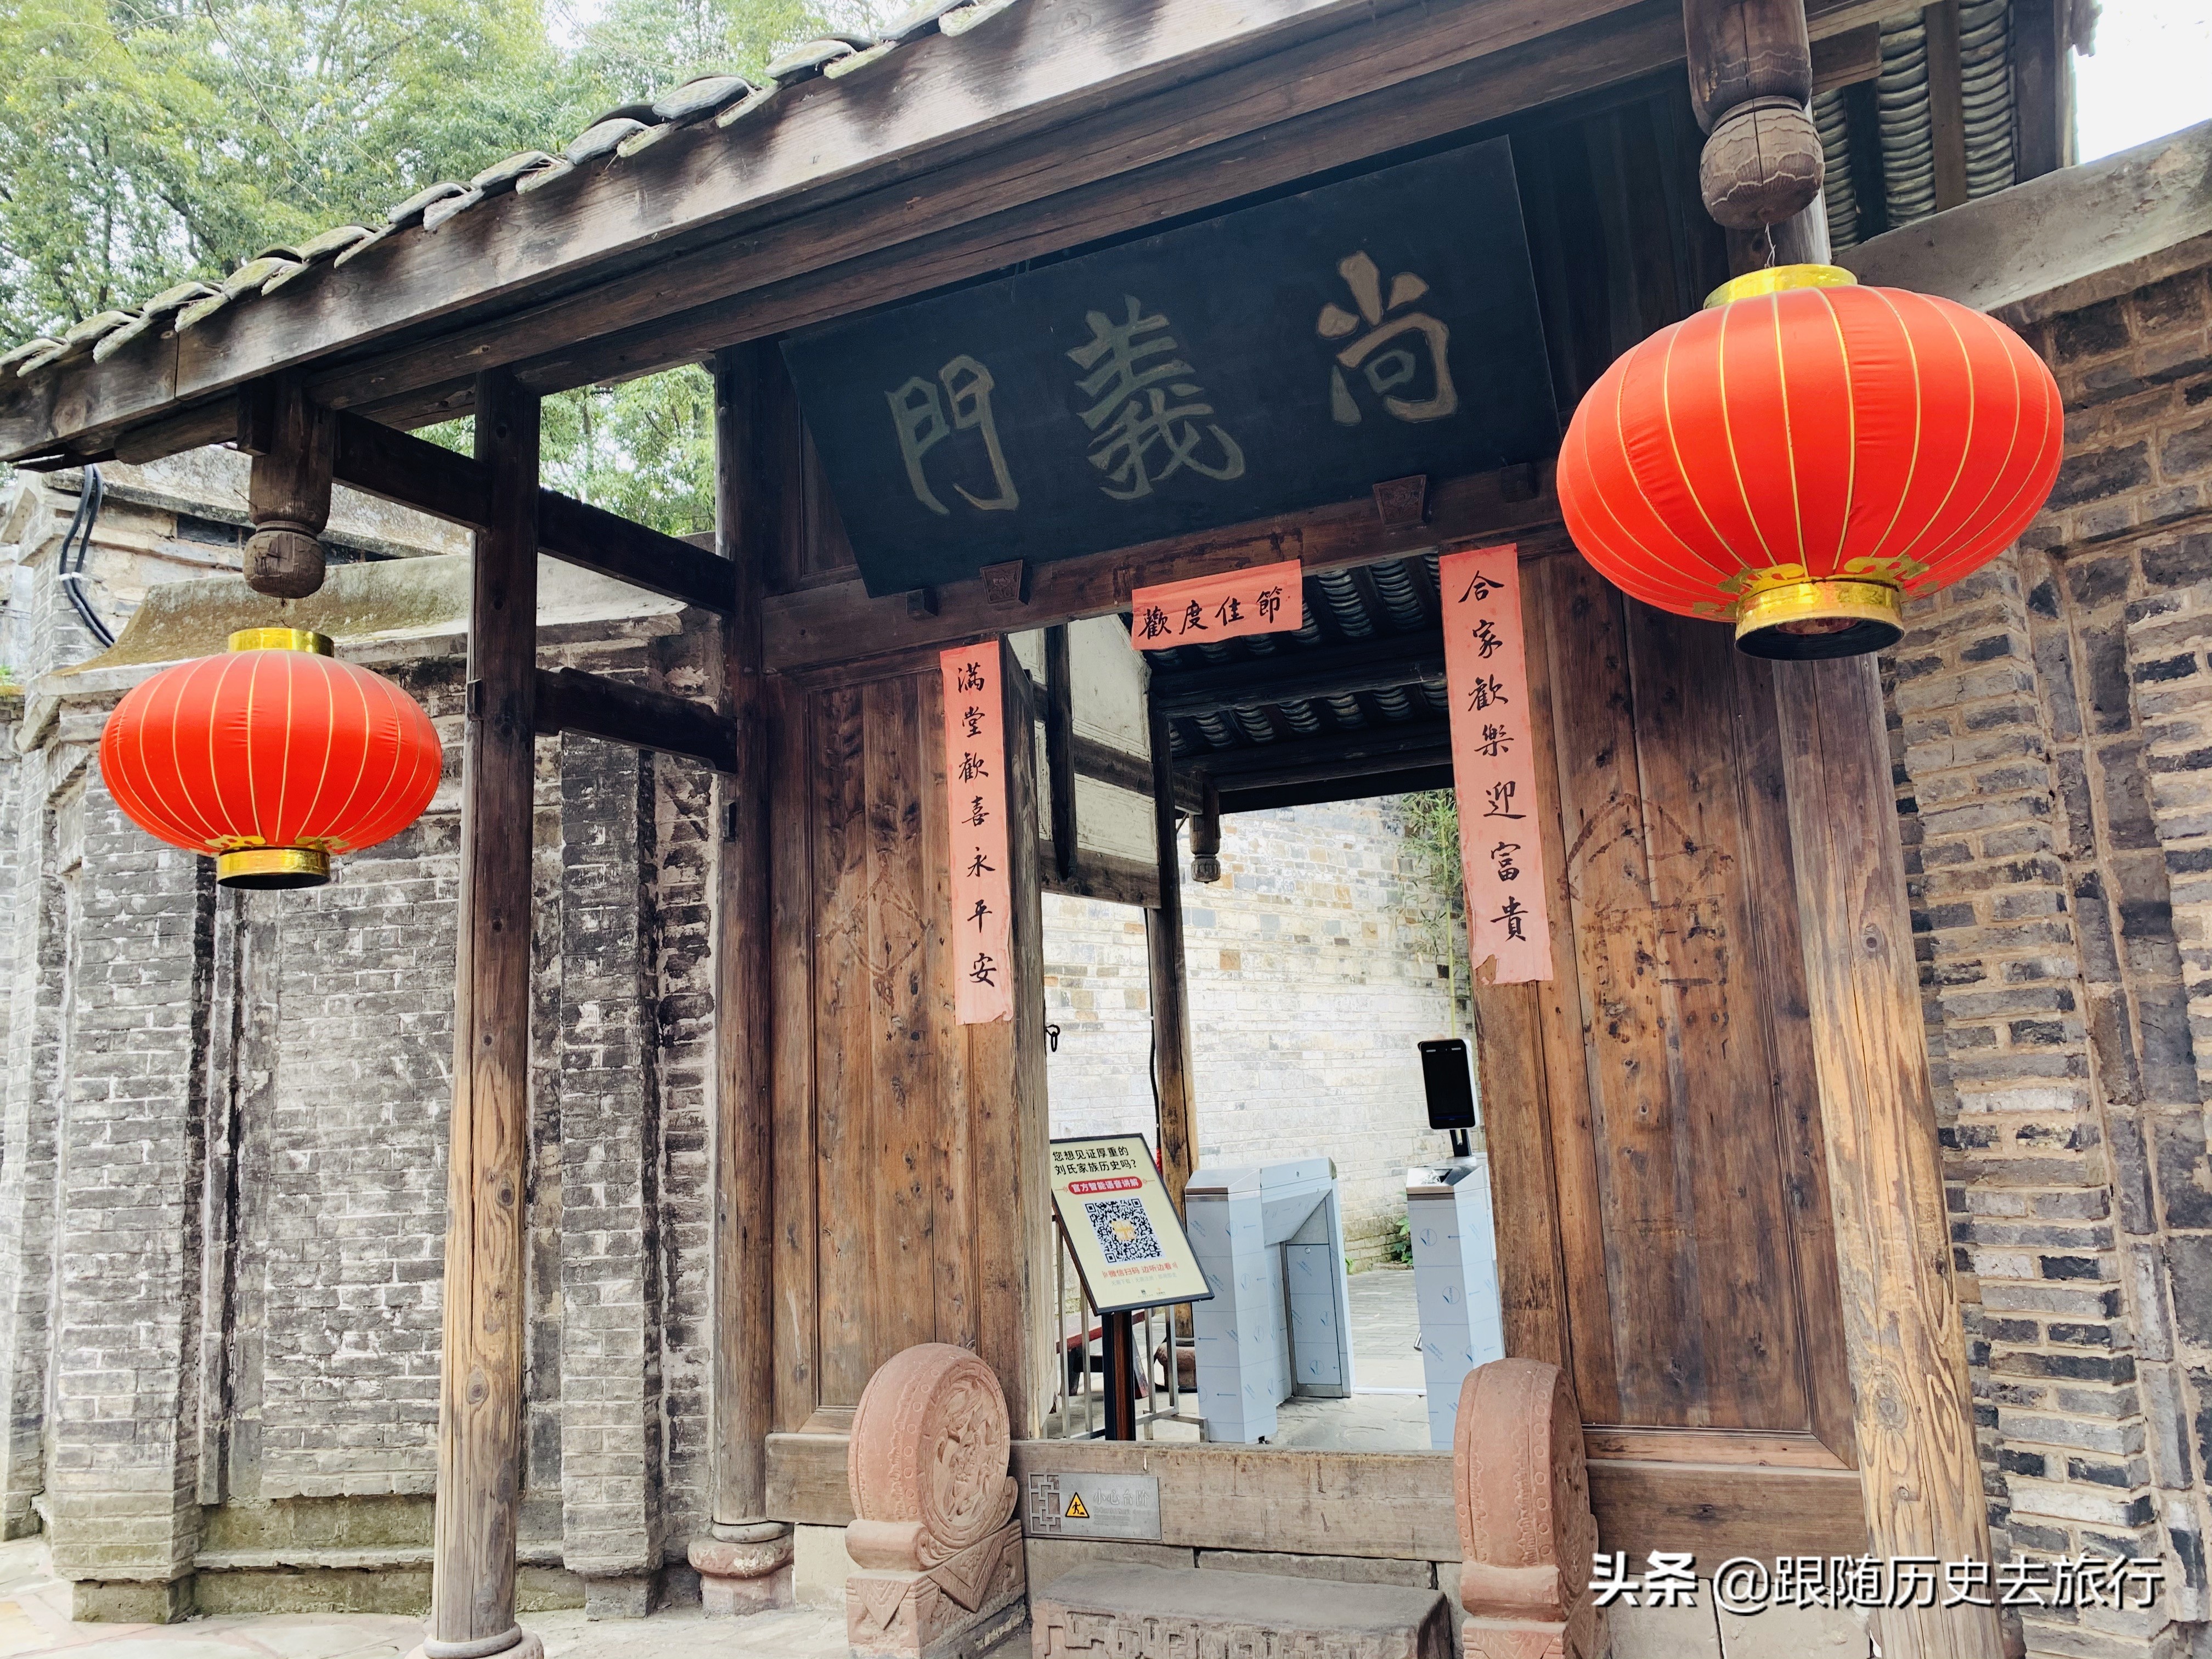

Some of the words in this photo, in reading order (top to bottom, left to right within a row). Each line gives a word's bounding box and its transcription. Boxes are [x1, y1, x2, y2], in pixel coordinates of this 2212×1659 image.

[1052, 1146, 1129, 1161] 您想见证厚重的
[1071, 1178, 1139, 1193] 官方智能语音讲解
[1093, 1488, 1149, 1506] 小心台阶
